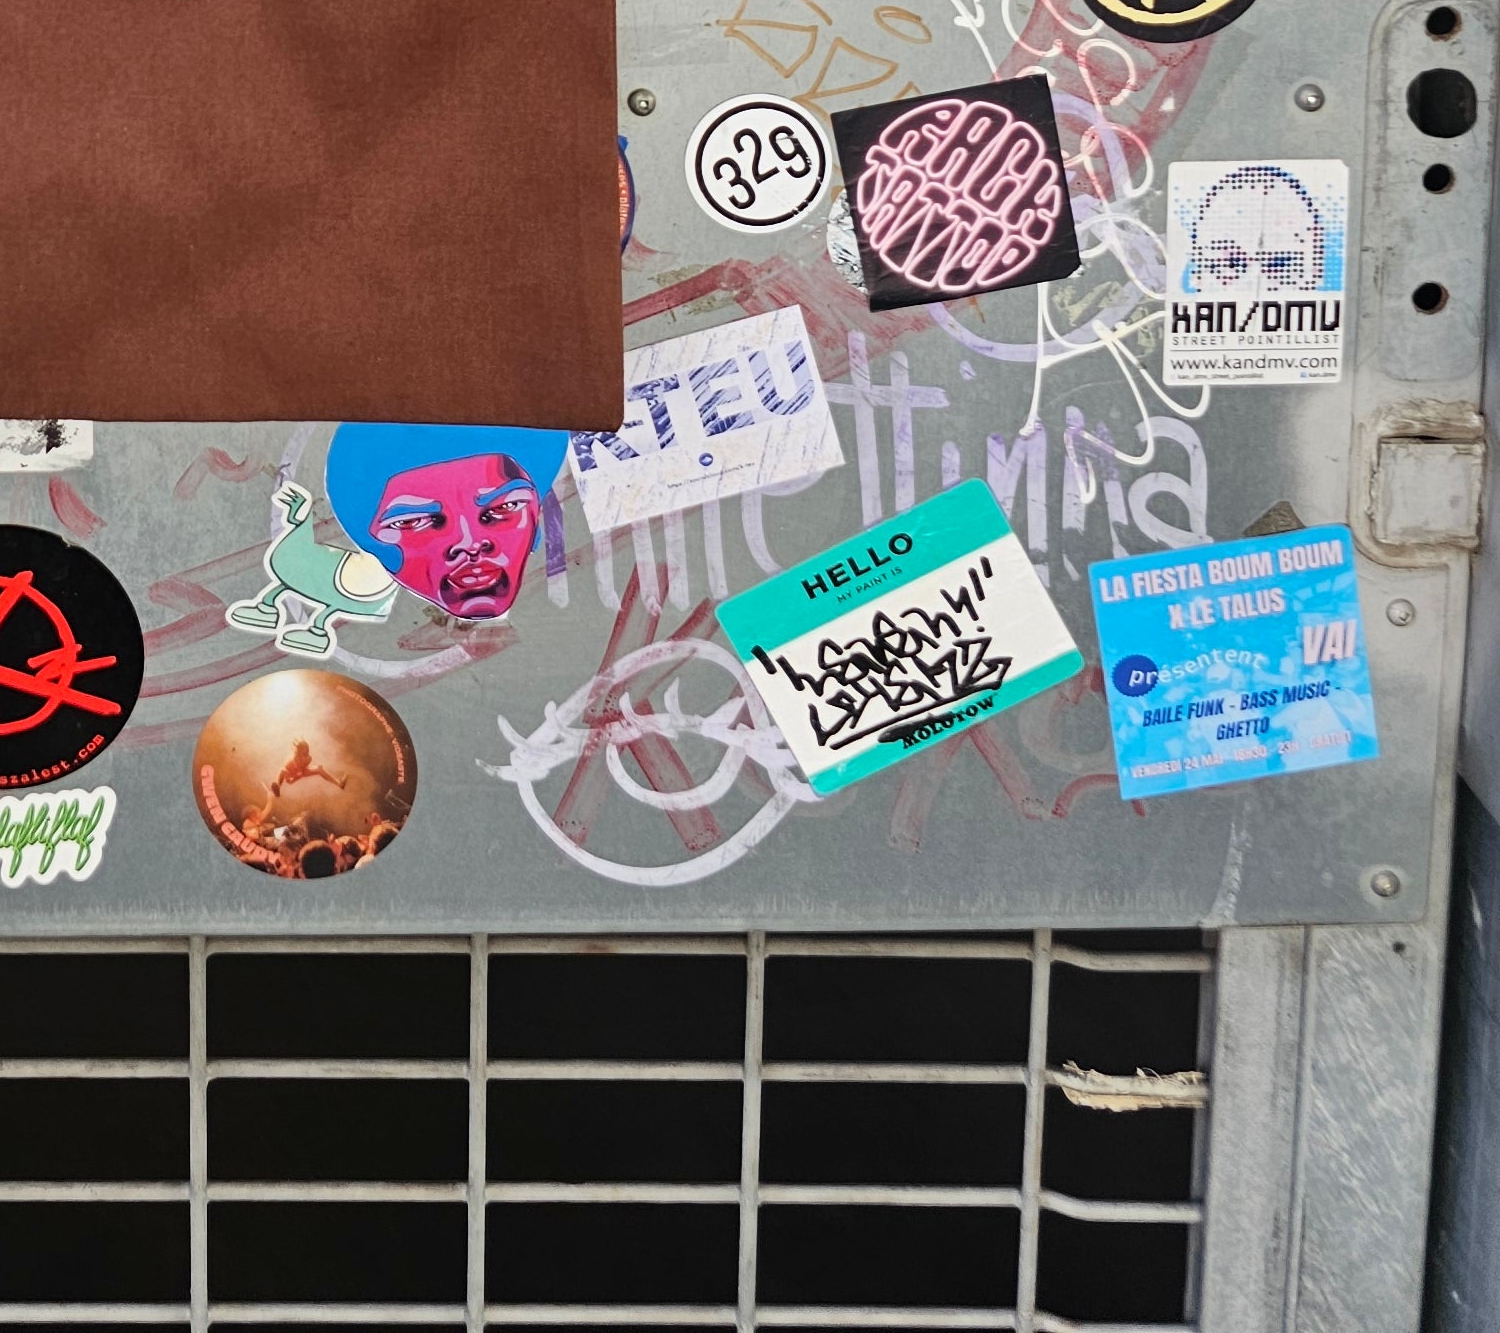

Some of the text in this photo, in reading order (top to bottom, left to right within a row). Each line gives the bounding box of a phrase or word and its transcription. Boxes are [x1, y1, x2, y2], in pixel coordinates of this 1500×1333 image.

[1172, 333, 1340, 346] STREET POINTILLIST
[1171, 354, 1338, 370] www.kandmv.com
[801, 532, 914, 600] HELLO
[836, 566, 903, 604] MY PAINT IS
[1100, 539, 1345, 604] LA FIESTA BOUM BOUM
[1188, 597, 1216, 628] LE
[1220, 586, 1288, 622] TALUS
[1128, 647, 1271, 688] présentent
[902, 695, 997, 751] MOLOTOW
[1142, 702, 1183, 728] BAILE
[1186, 697, 1226, 722] FUNK
[1239, 688, 1279, 712] BASS
[1282, 679, 1332, 704] MUSIC
[1216, 715, 1271, 742] GHETTO
